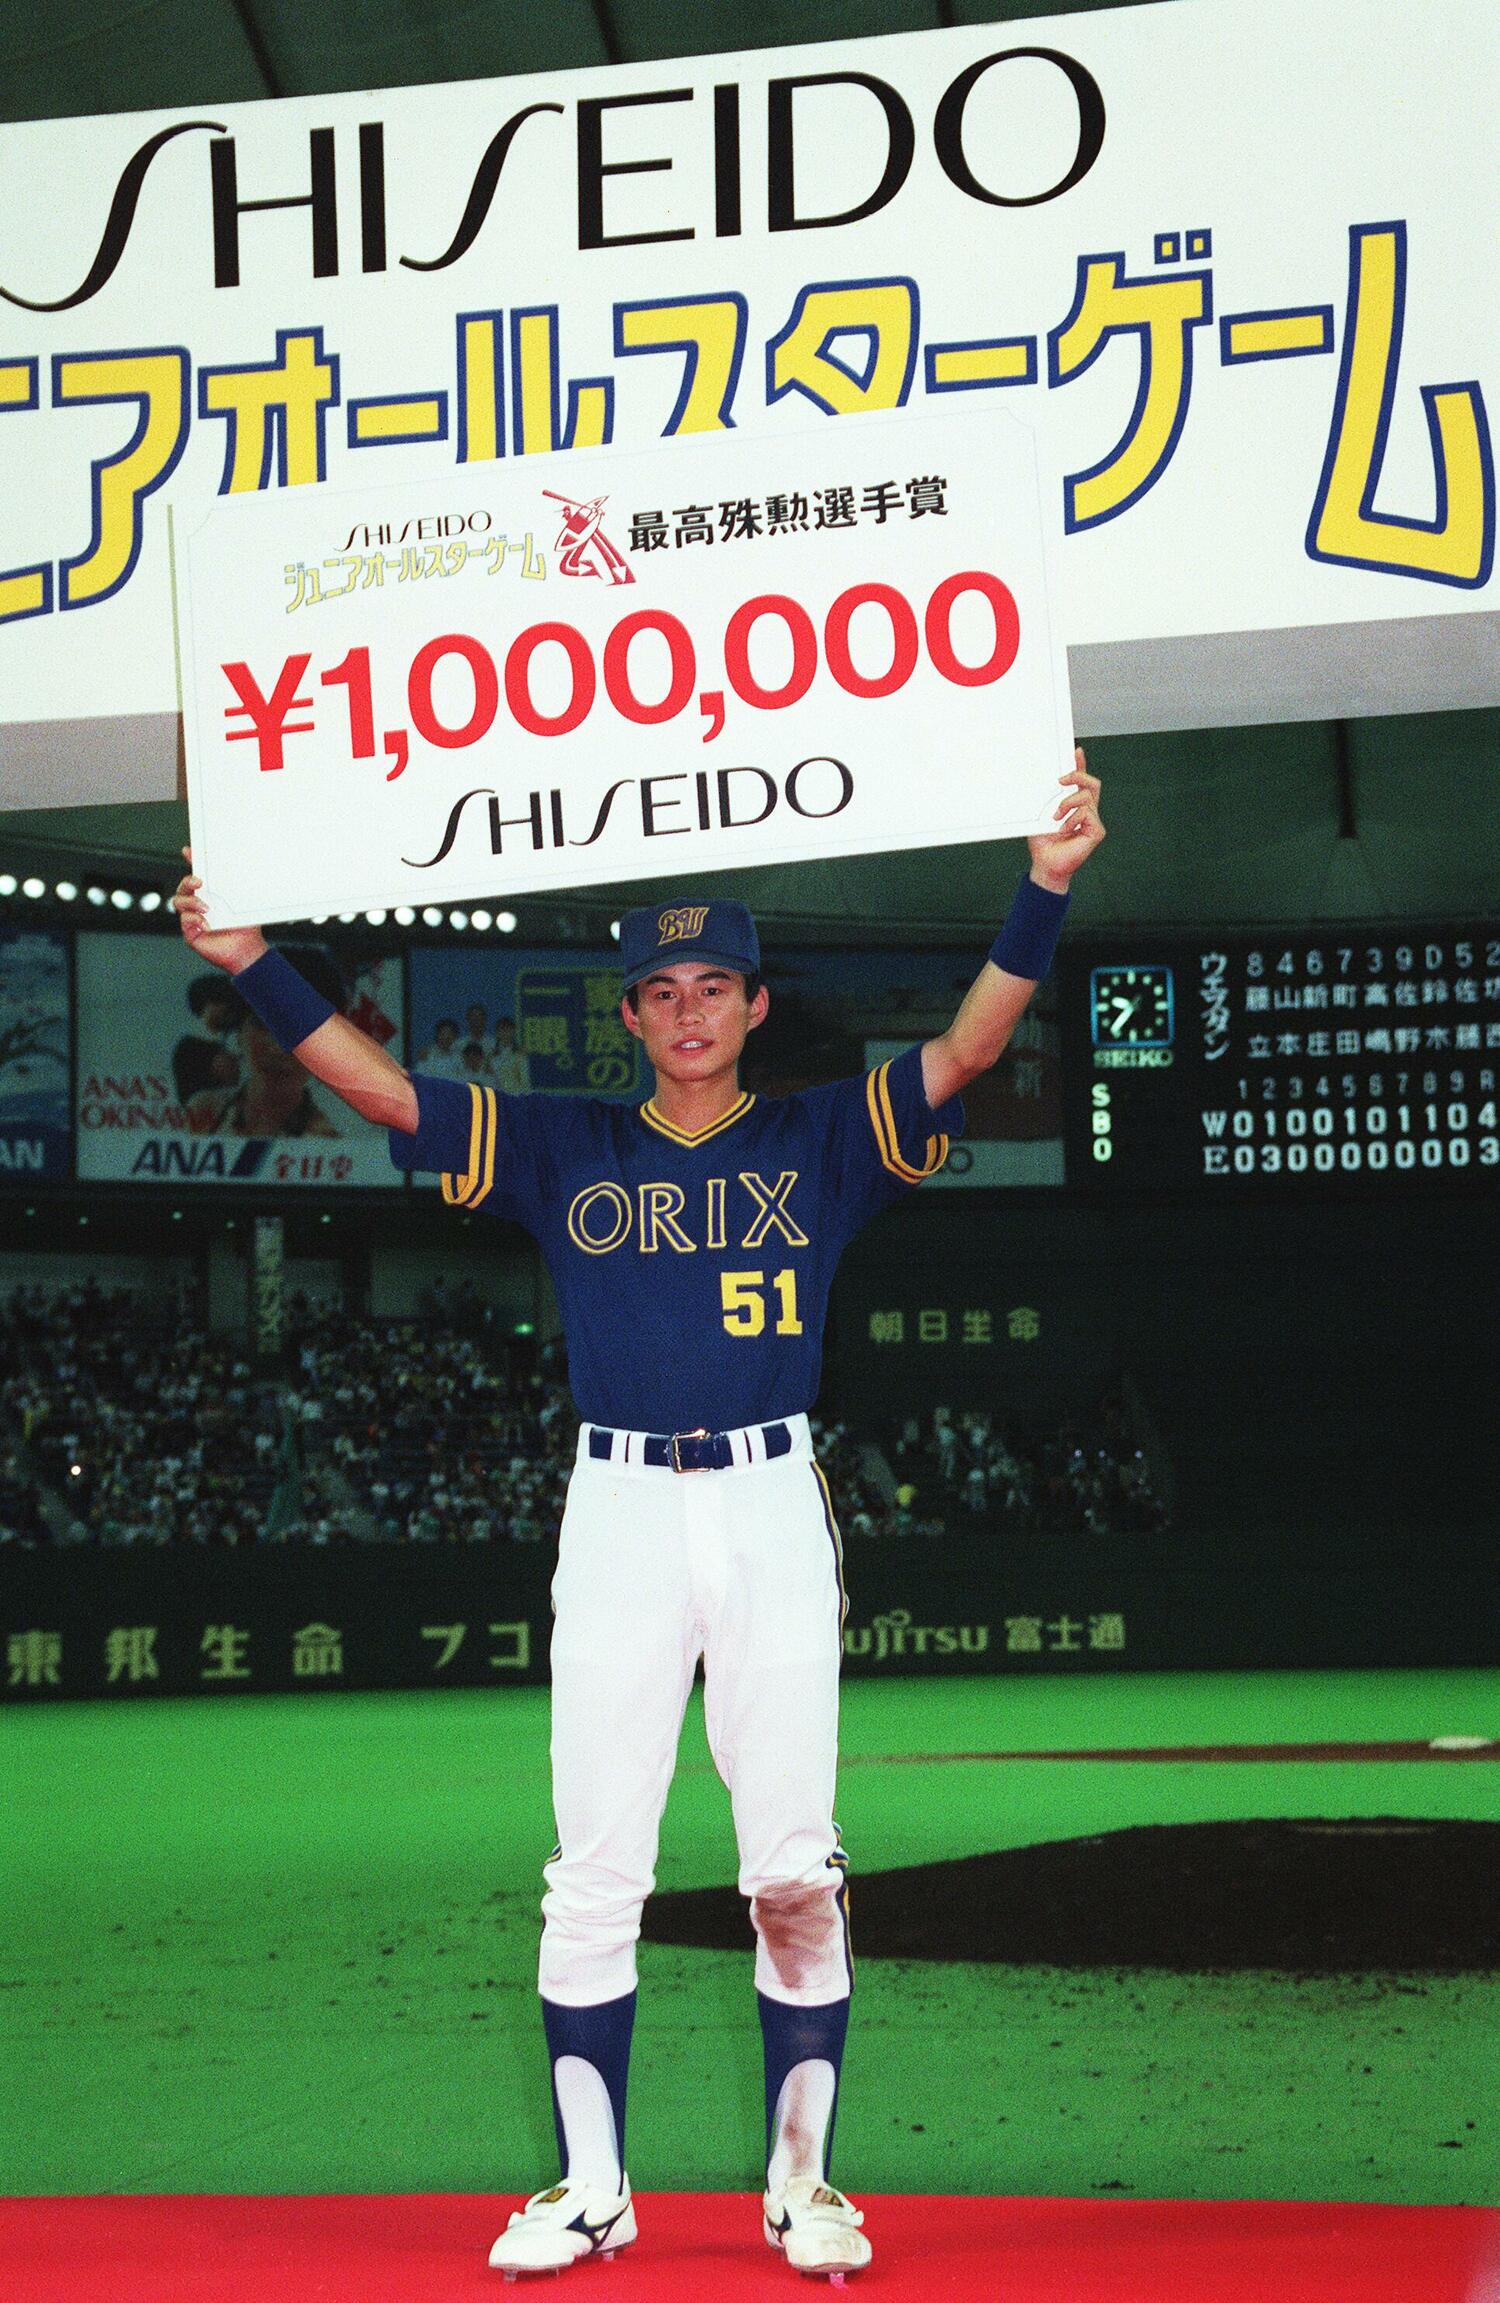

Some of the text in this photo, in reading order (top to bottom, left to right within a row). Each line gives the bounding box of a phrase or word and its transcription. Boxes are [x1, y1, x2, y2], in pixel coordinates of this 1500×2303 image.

[0, 46, 1106, 312] SHISEIDO
[333, 510, 492, 552] SHISEIDO
[628, 475, 949, 552] 最高殊勲選手賞
[284, 533, 546, 614] ジュニアオールスターゲーム
[221, 570, 1020, 781] ¥1,000,000
[401, 756, 854, 868] SHISEIDO
[1093, 1049, 1173, 1068] SEIKO
[1238, 1079, 1247, 1099] 1
[1263, 1078, 1276, 1100] 2
[1290, 1077, 1303, 1099] 3
[1316, 1075, 1330, 1097] 4
[1342, 1075, 1356, 1098] 5
[1369, 1073, 1382, 1096] 6
[1397, 1072, 1409, 1093] 7
[1423, 1071, 1437, 1094] 8
[1450, 1070, 1464, 1093] 9
[130, 1140, 226, 1176] ANA
[568, 1171, 809, 1254] ORIX
[721, 1269, 802, 1336] 51
[868, 1307, 1041, 1344] 朝日生命
[6, 1621, 345, 1686] 東邦生命
[844, 1609, 1126, 1661] UJITSU 富士通
